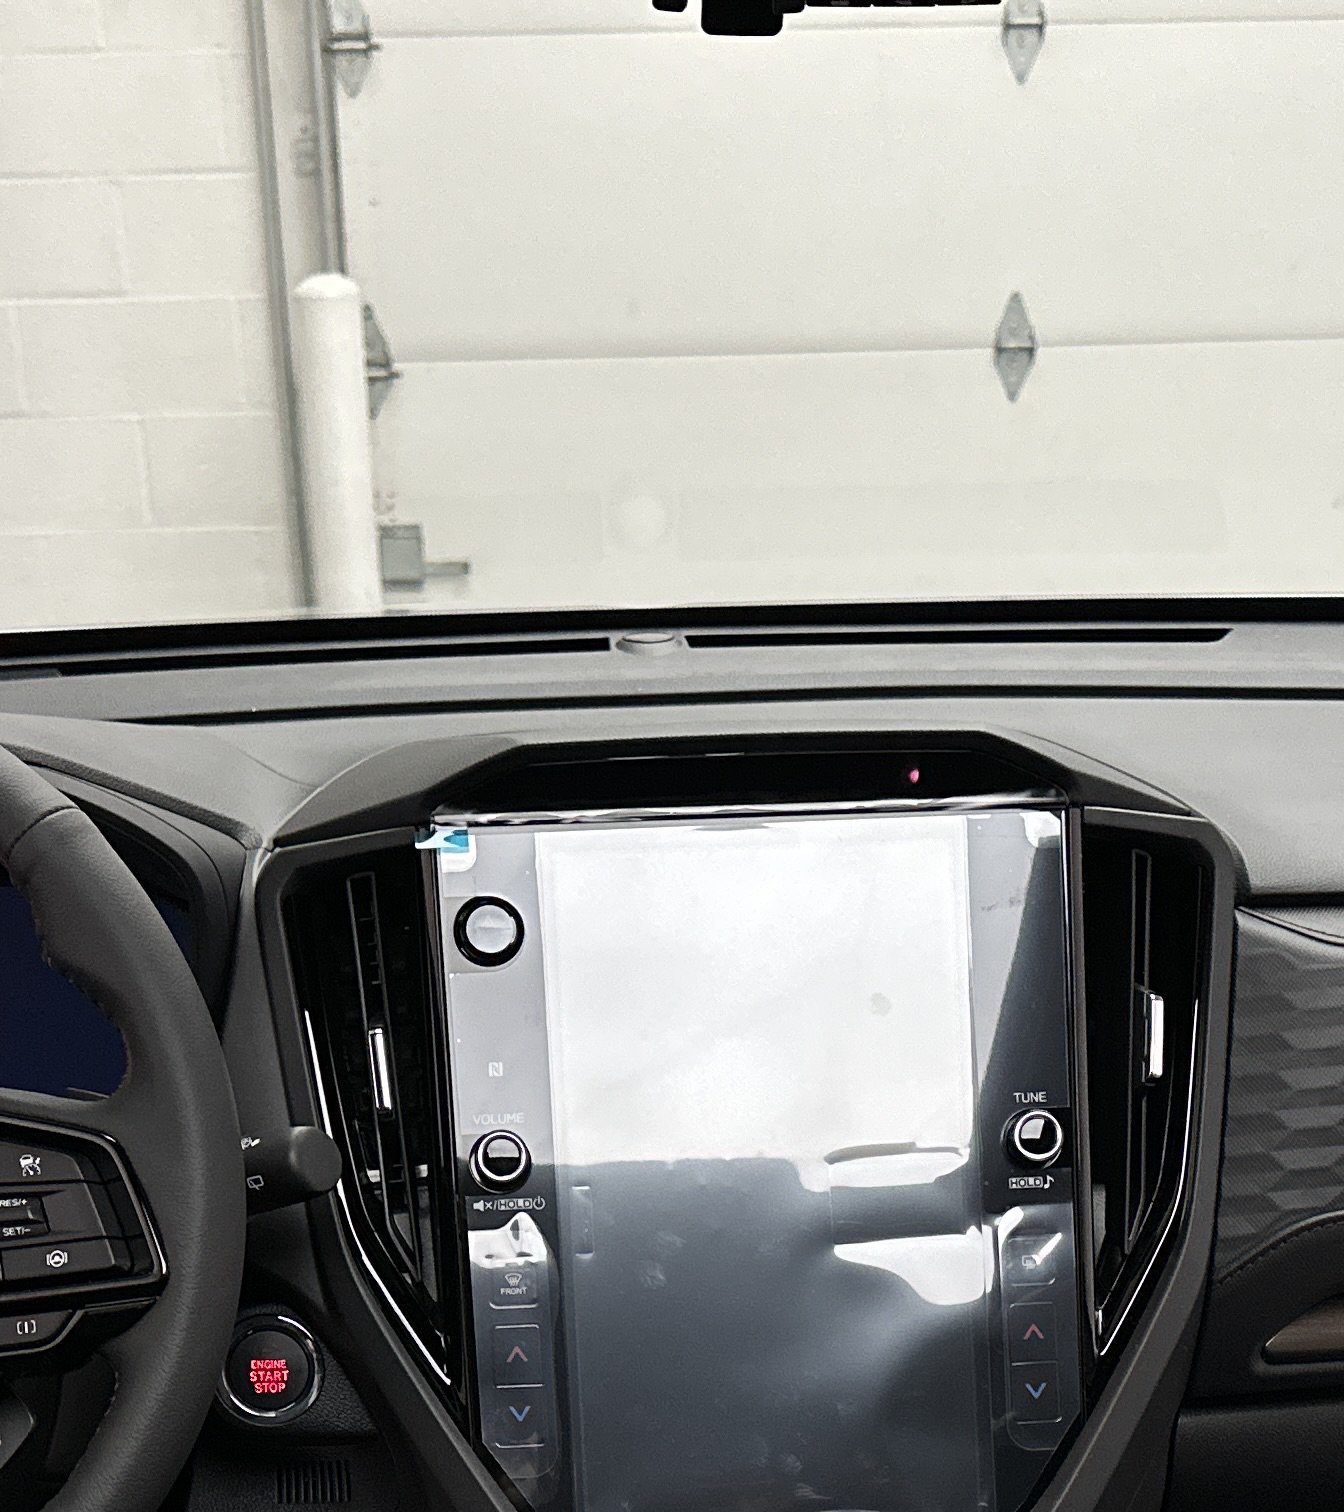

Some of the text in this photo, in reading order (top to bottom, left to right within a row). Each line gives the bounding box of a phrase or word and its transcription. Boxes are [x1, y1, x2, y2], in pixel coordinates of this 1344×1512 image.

[1013, 1092, 1047, 1103] TUNE
[473, 1112, 525, 1125] VOLUME
[1009, 1175, 1044, 1189] HOLD
[497, 1197, 533, 1210] HOLD
[500, 1285, 527, 1296] FRONT
[250, 1359, 287, 1370] ENGINE
[249, 1370, 290, 1382] START
[254, 1381, 286, 1394] STOP
